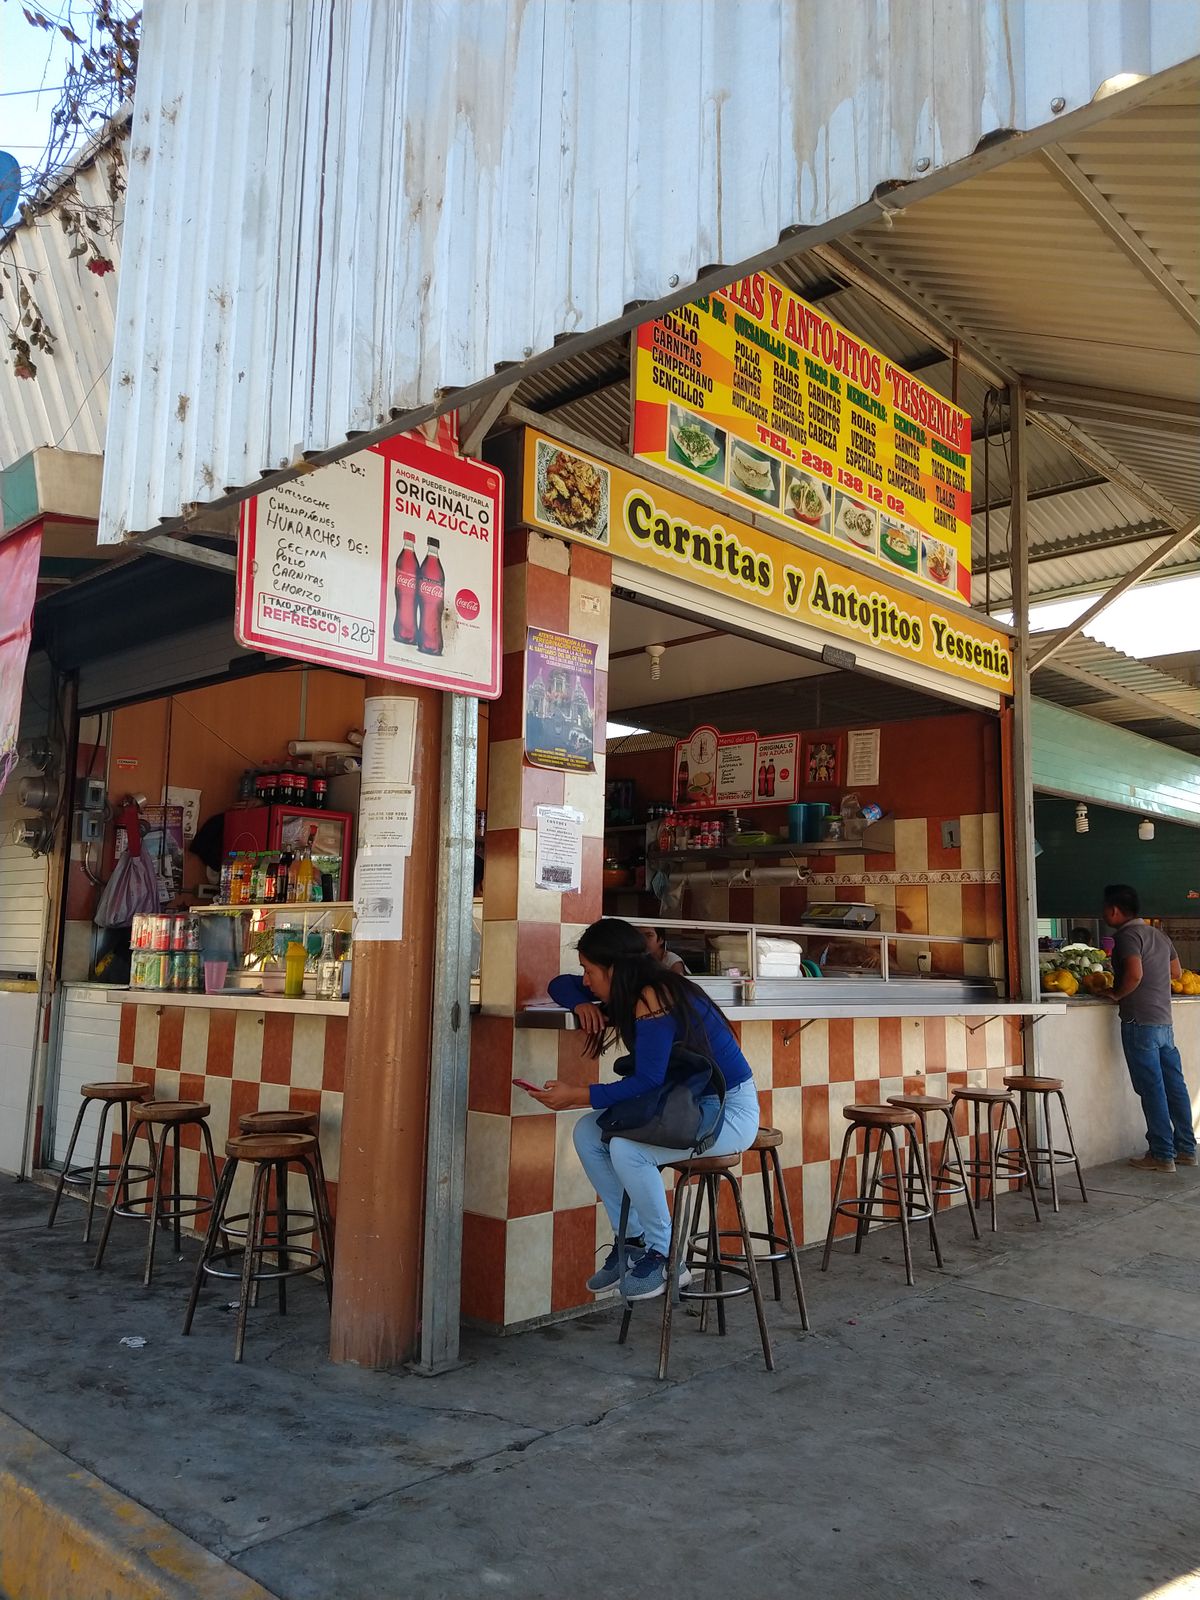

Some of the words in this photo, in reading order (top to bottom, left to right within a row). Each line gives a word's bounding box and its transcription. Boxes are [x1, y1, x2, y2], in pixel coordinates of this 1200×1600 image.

[654, 313, 698, 346] OLLO
[768, 283, 782, 331] Y
[784, 298, 881, 397] ANTOJITOS
[653, 326, 702, 368] CARNITAS
[735, 340, 760, 366] POLLO
[652, 346, 713, 393] CAMPECHANO
[734, 354, 762, 384] TLALES
[773, 361, 800, 389] RAJAS
[804, 357, 829, 387] TACOS
[653, 365, 704, 409] SENCILLOS
[733, 372, 760, 400] CARNITAS
[773, 378, 803, 407] CHORIZO
[808, 381, 841, 415] CARNITAS
[732, 390, 769, 424] HUITLACOCHE
[773, 395, 805, 425] ESPECIALES
[808, 401, 841, 434] CUERITOS
[808, 422, 838, 452] CABEZA
[851, 410, 876, 437] ROJAS
[850, 429, 876, 459] VERDES
[895, 433, 920, 462] CARNITAS
[756, 423, 796, 459] TEL.
[802, 449, 833, 478] 238
[838, 468, 863, 493] 138
[868, 483, 883, 505] 12
[887, 494, 905, 515] 02
[846, 447, 883, 482] ESPECIALES
[895, 453, 920, 481] CUERITOS
[931, 457, 945, 483] TACOS
[946, 466, 952, 487] DE
[396, 468, 420, 482] AHORA
[422, 478, 447, 493] PUEDES
[448, 488, 490, 509] DISFRUTARLA
[887, 468, 926, 503] CAMPECHANA
[935, 485, 956, 511] TLALES
[396, 479, 474, 520] ORIGINAL
[478, 510, 490, 525] O
[267, 510, 341, 548] HUARACHES
[348, 538, 369, 555] DE:
[395, 497, 421, 519] SIN
[426, 509, 489, 543] AZÚCAR
[933, 506, 957, 534] CARNITAS
[276, 548, 306, 568] POLLO
[277, 538, 327, 559] CECINA
[272, 563, 324, 588] CARNITAS
[273, 579, 321, 602] CHORIZO
[628, 497, 770, 588] Carnitas
[786, 572, 801, 606] y
[812, 574, 921, 646] Antojitos
[932, 620, 1009, 676] Yessenia
[268, 597, 292, 610] TACO
[263, 606, 337, 634] REFRESCO
[759, 743, 787, 752] ORIGINAL
[759, 750, 769, 758] SIN
